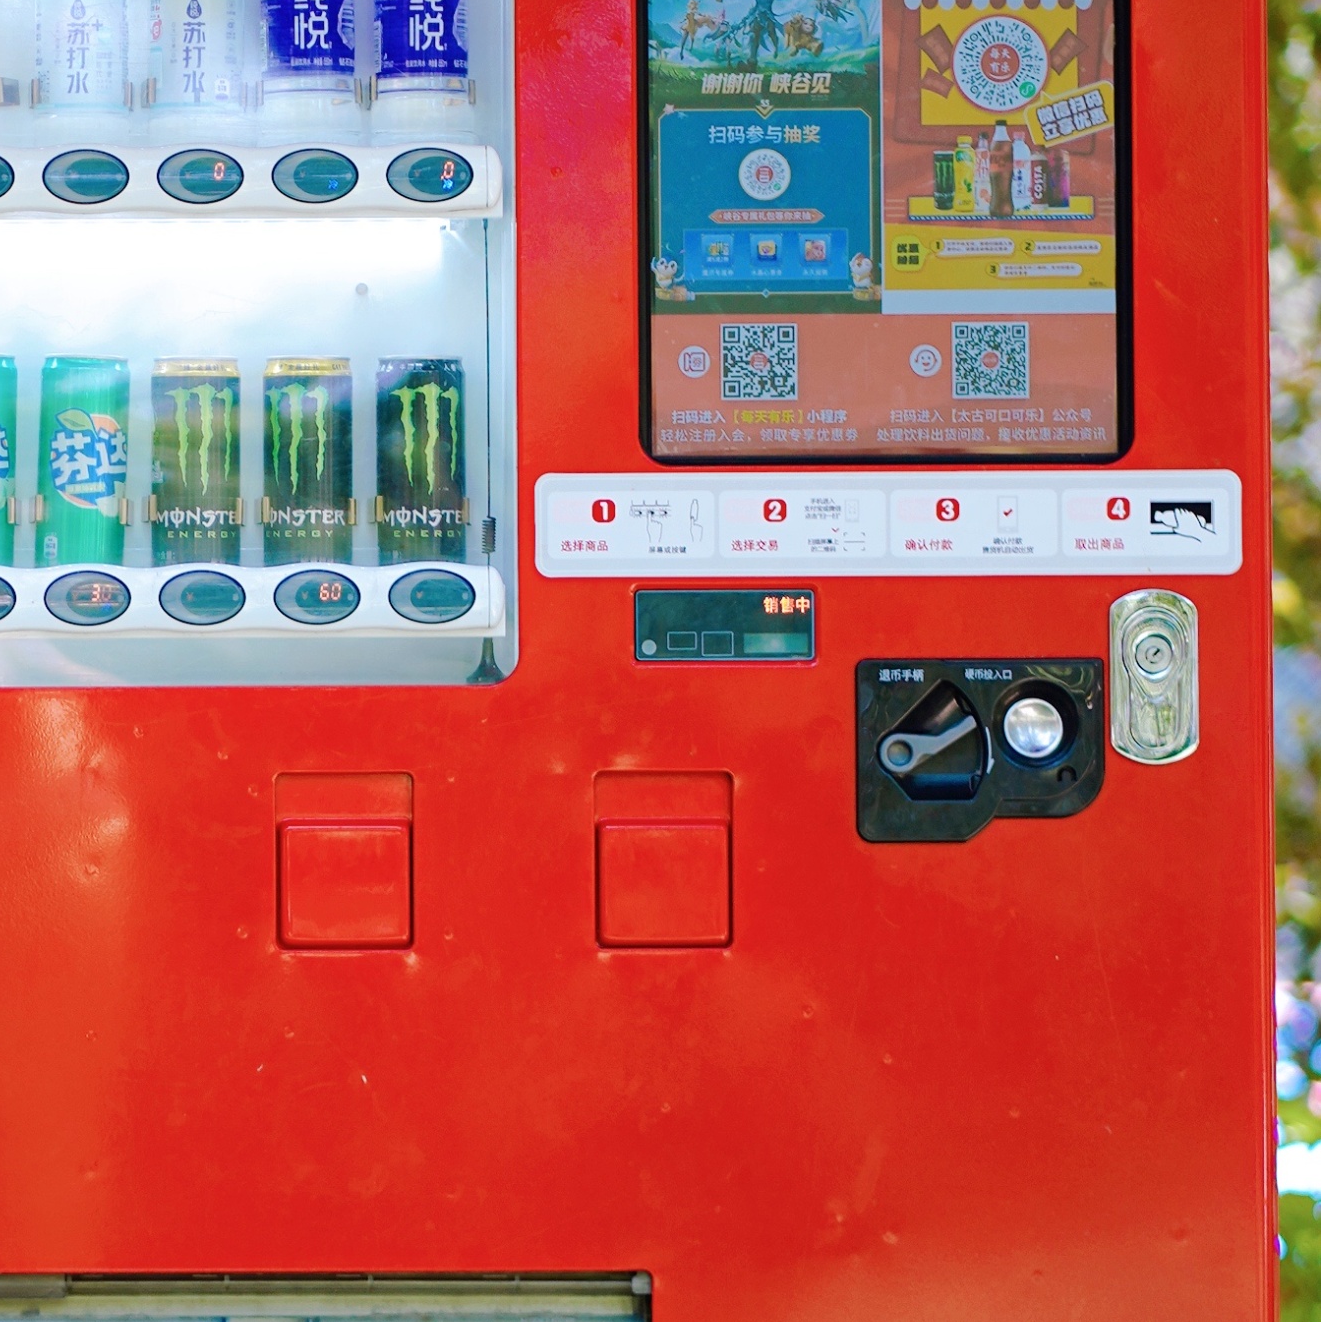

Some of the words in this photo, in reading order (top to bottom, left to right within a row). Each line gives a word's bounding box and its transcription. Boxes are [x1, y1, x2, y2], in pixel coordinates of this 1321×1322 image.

[183, 22, 206, 93] 苏打水
[701, 73, 763, 94] 谢谢你
[769, 72, 832, 94] 峡谷见
[708, 125, 821, 144] 扫码参与抽奖
[51, 431, 127, 487] 芬达
[156, 507, 237, 527] MONSTE
[267, 507, 346, 527] ONSTER
[382, 506, 464, 527] MONSTE
[560, 540, 609, 552] 选择商品
[731, 539, 779, 552] 选择交易
[904, 539, 953, 551] 确认付款
[1074, 538, 1125, 551] 取出商品
[762, 595, 811, 614] 销售中
[878, 668, 924, 682] 退币手柄
